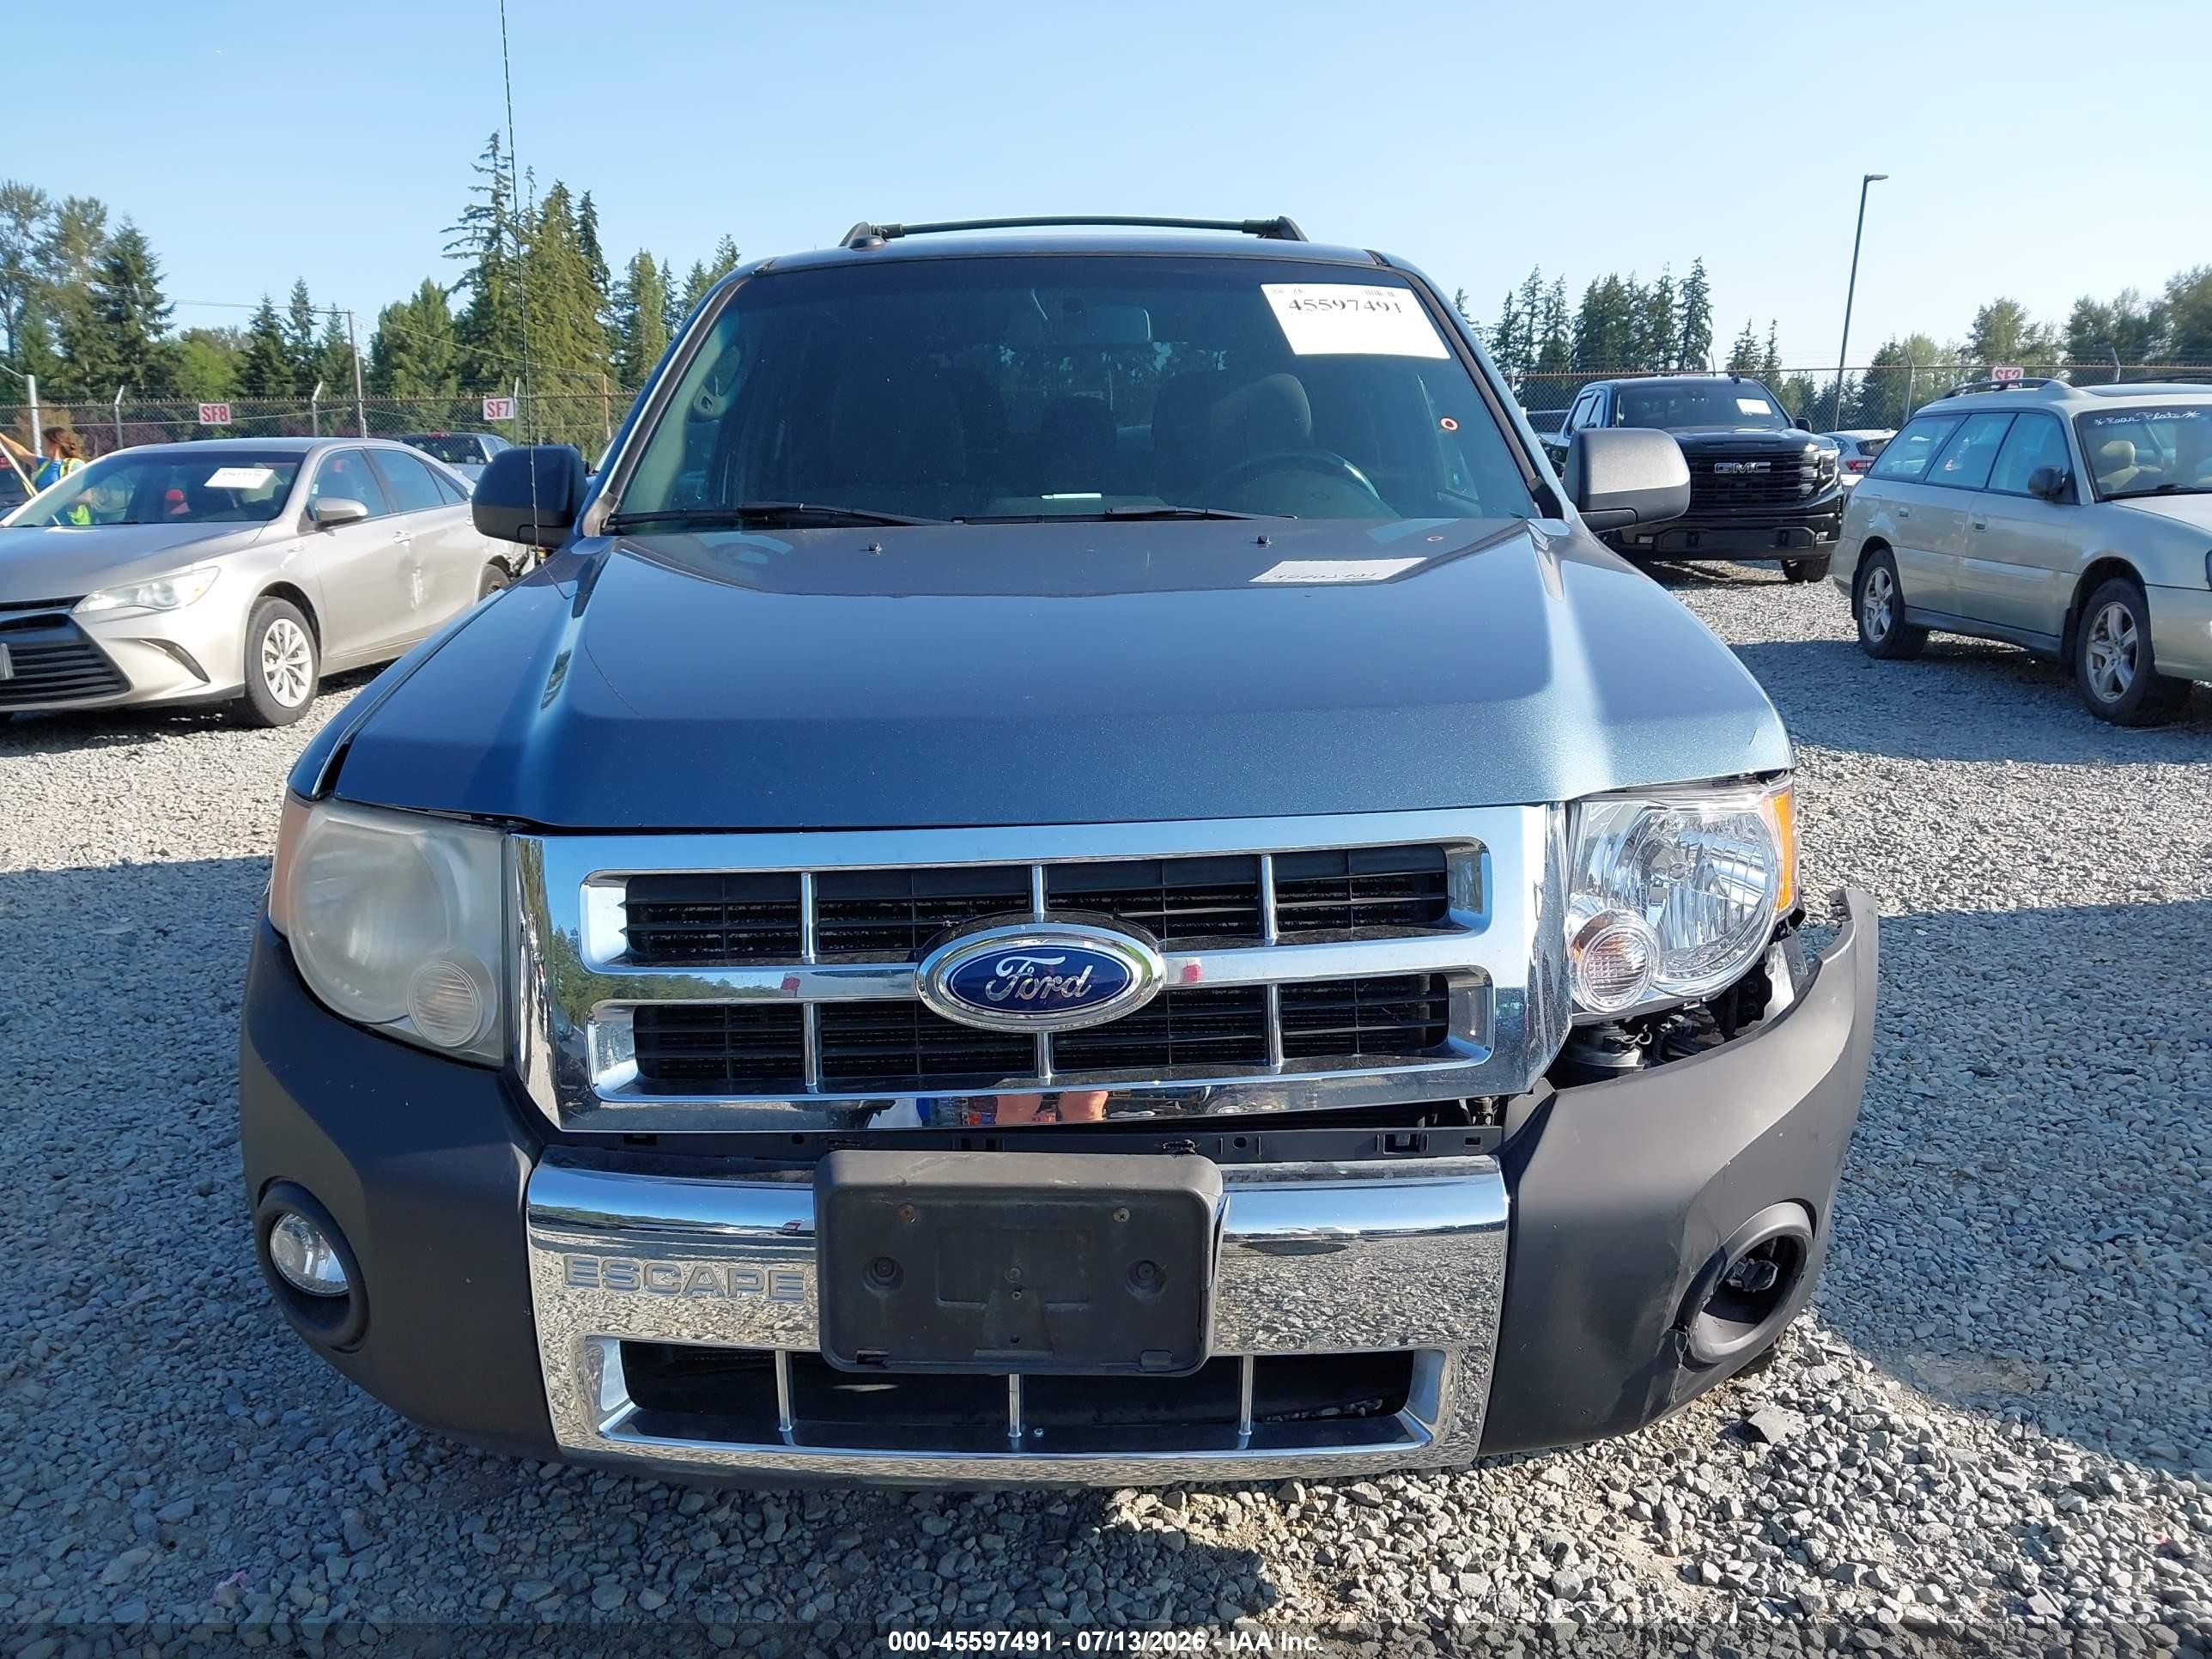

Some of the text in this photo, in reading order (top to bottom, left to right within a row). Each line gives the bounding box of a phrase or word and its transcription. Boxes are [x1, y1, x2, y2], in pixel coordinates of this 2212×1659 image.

[1289, 299, 1401, 313] 45597491
[202, 405, 228, 422] SF8
[487, 401, 509, 417] SF7
[1714, 462, 1771, 473] GMC
[985, 955, 1094, 1001] Ford
[563, 1255, 806, 1303] ESCAPE
